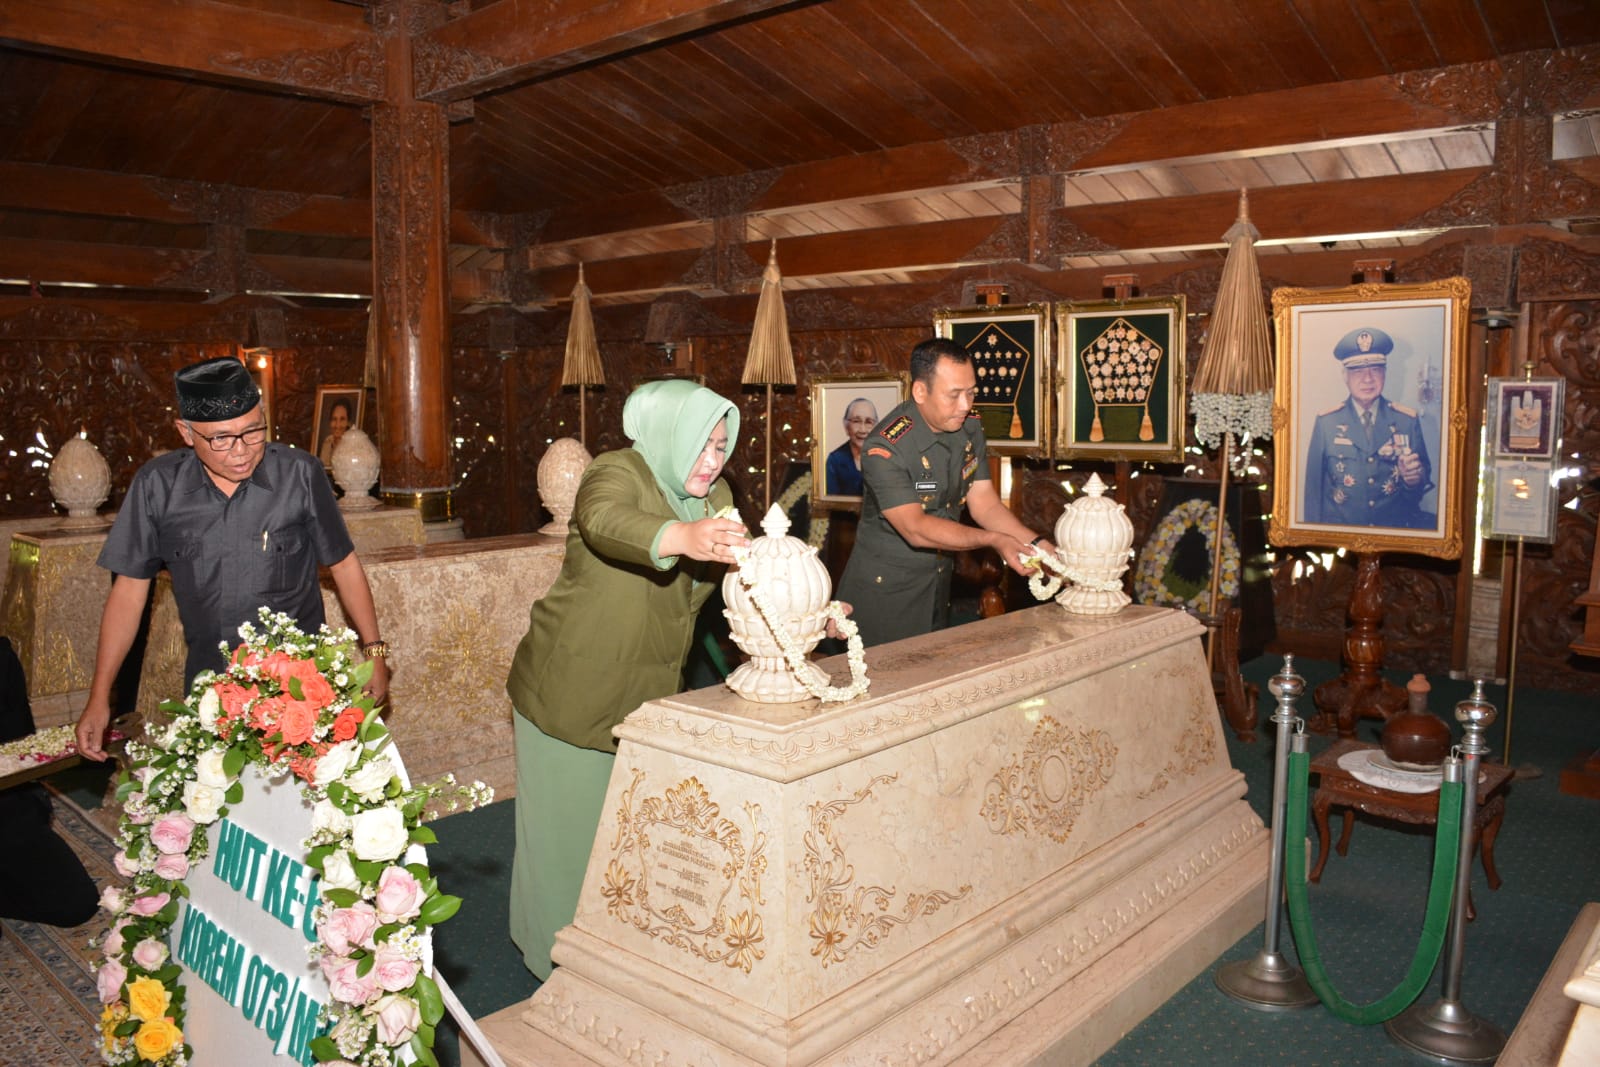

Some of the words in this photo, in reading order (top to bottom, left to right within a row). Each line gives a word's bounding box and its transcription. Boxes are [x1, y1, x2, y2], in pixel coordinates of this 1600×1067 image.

[213, 818, 269, 901] HUT
[178, 903, 246, 1007] KOREM
[242, 954, 337, 1067] 073/M
